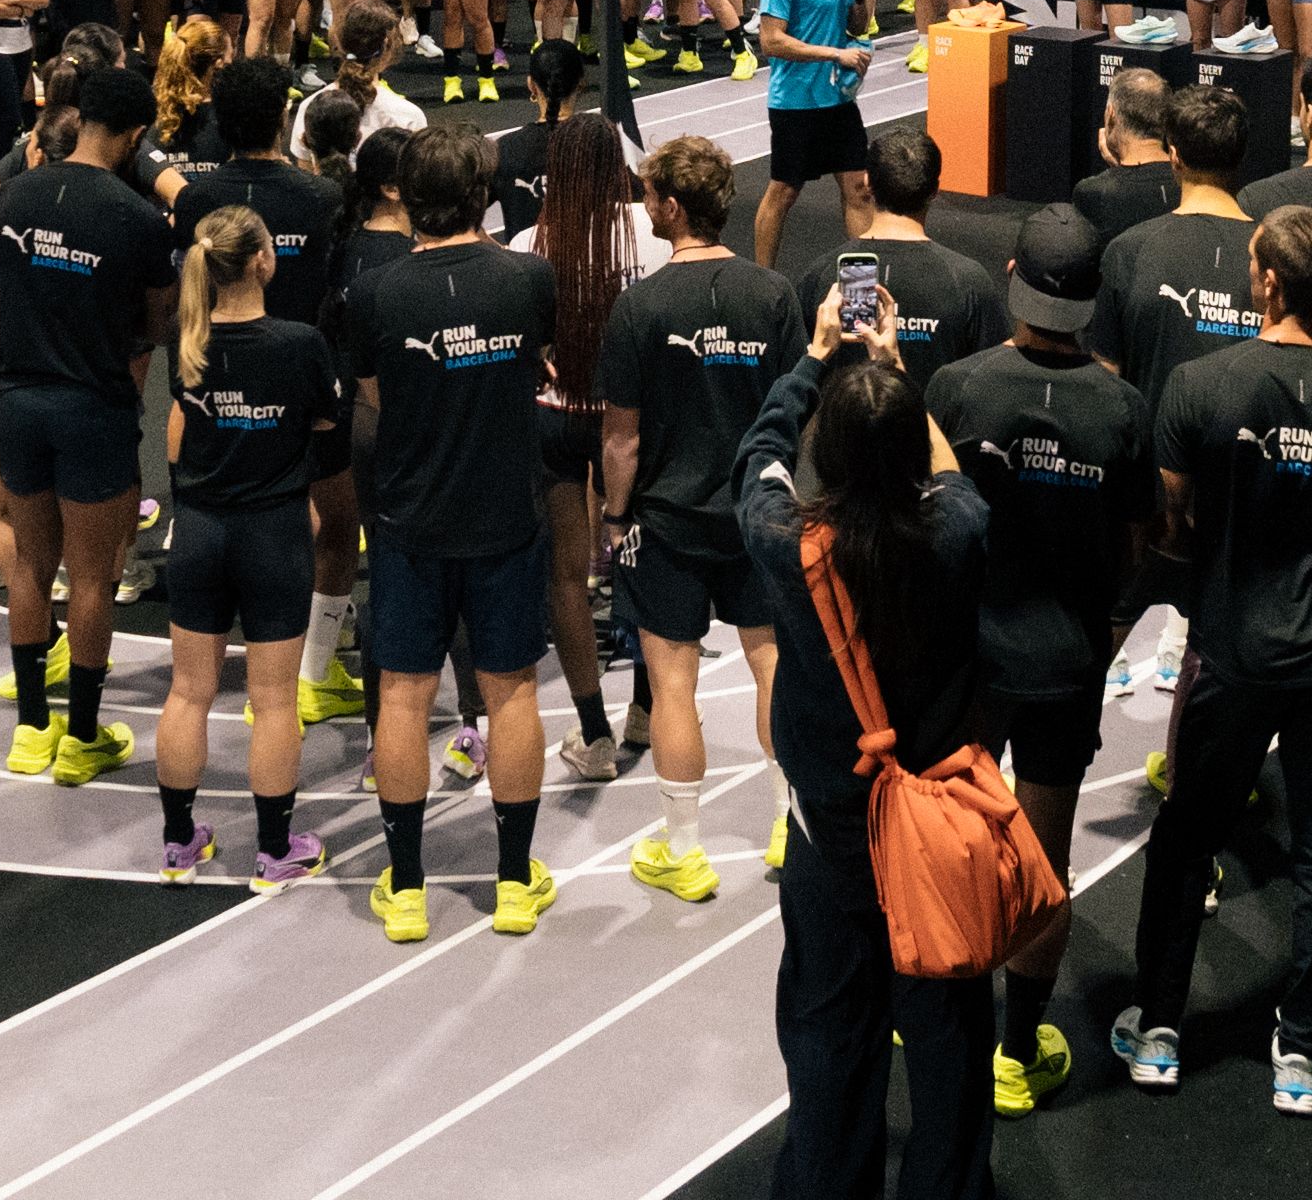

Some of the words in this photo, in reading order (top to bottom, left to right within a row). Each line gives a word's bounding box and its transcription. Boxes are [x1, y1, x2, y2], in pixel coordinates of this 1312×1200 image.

[1014, 44, 1035, 57] RACE
[1014, 55, 1029, 66] DAY
[1100, 54, 1124, 67] EVERY
[1100, 64, 1116, 76] DAY
[1198, 63, 1223, 76] EVERY
[1198, 74, 1215, 86] DAY
[196, 162, 220, 173] CITY
[33, 229, 64, 246] RUN
[275, 234, 308, 246] CITY
[33, 242, 69, 260] YOUR
[70, 249, 103, 268] CITY
[31, 255, 93, 277] BARCELONA
[1198, 289, 1231, 308] RUN
[1198, 305, 1240, 324] YOUR
[1241, 311, 1265, 327] CIT
[907, 317, 939, 333] CITY
[1196, 320, 1258, 337] BARCELON
[443, 325, 476, 343] RUN
[897, 330, 931, 341] ELONA
[445, 339, 487, 358] YOUR
[488, 334, 523, 351] CITY
[738, 341, 767, 356] CITY
[445, 350, 517, 369] BARCELONA
[213, 391, 244, 404] RUN
[216, 405, 252, 418] YOUR
[252, 405, 285, 420] CITY
[1022, 437, 1059, 455] RUN
[1022, 454, 1066, 473] YOUR
[1069, 461, 1105, 483] CITY
